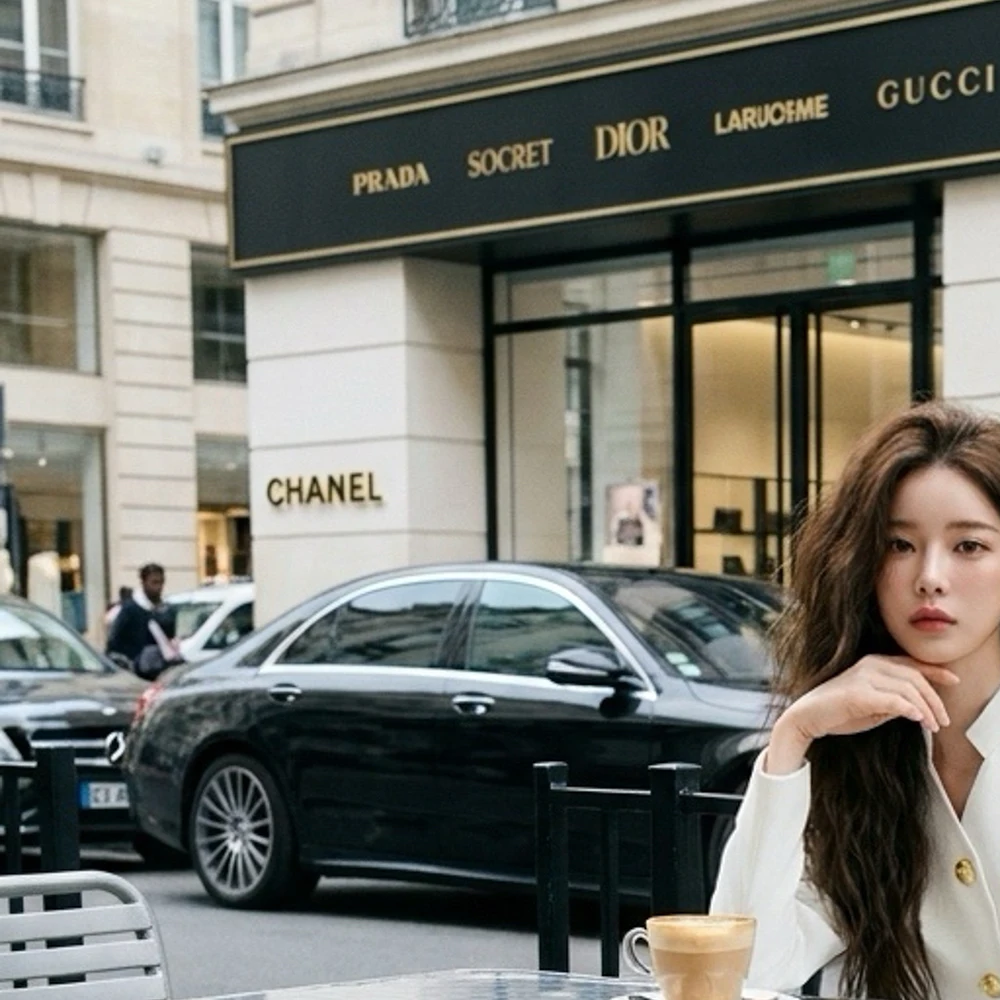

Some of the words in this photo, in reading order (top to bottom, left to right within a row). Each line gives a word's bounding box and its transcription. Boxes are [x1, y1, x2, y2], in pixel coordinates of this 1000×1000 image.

[352, 162, 431, 196] PRADA
[467, 138, 554, 178] SOCRET
[595, 115, 671, 161] DIOR
[876, 64, 995, 110] GUCCI
[266, 471, 383, 507] CHANEL
